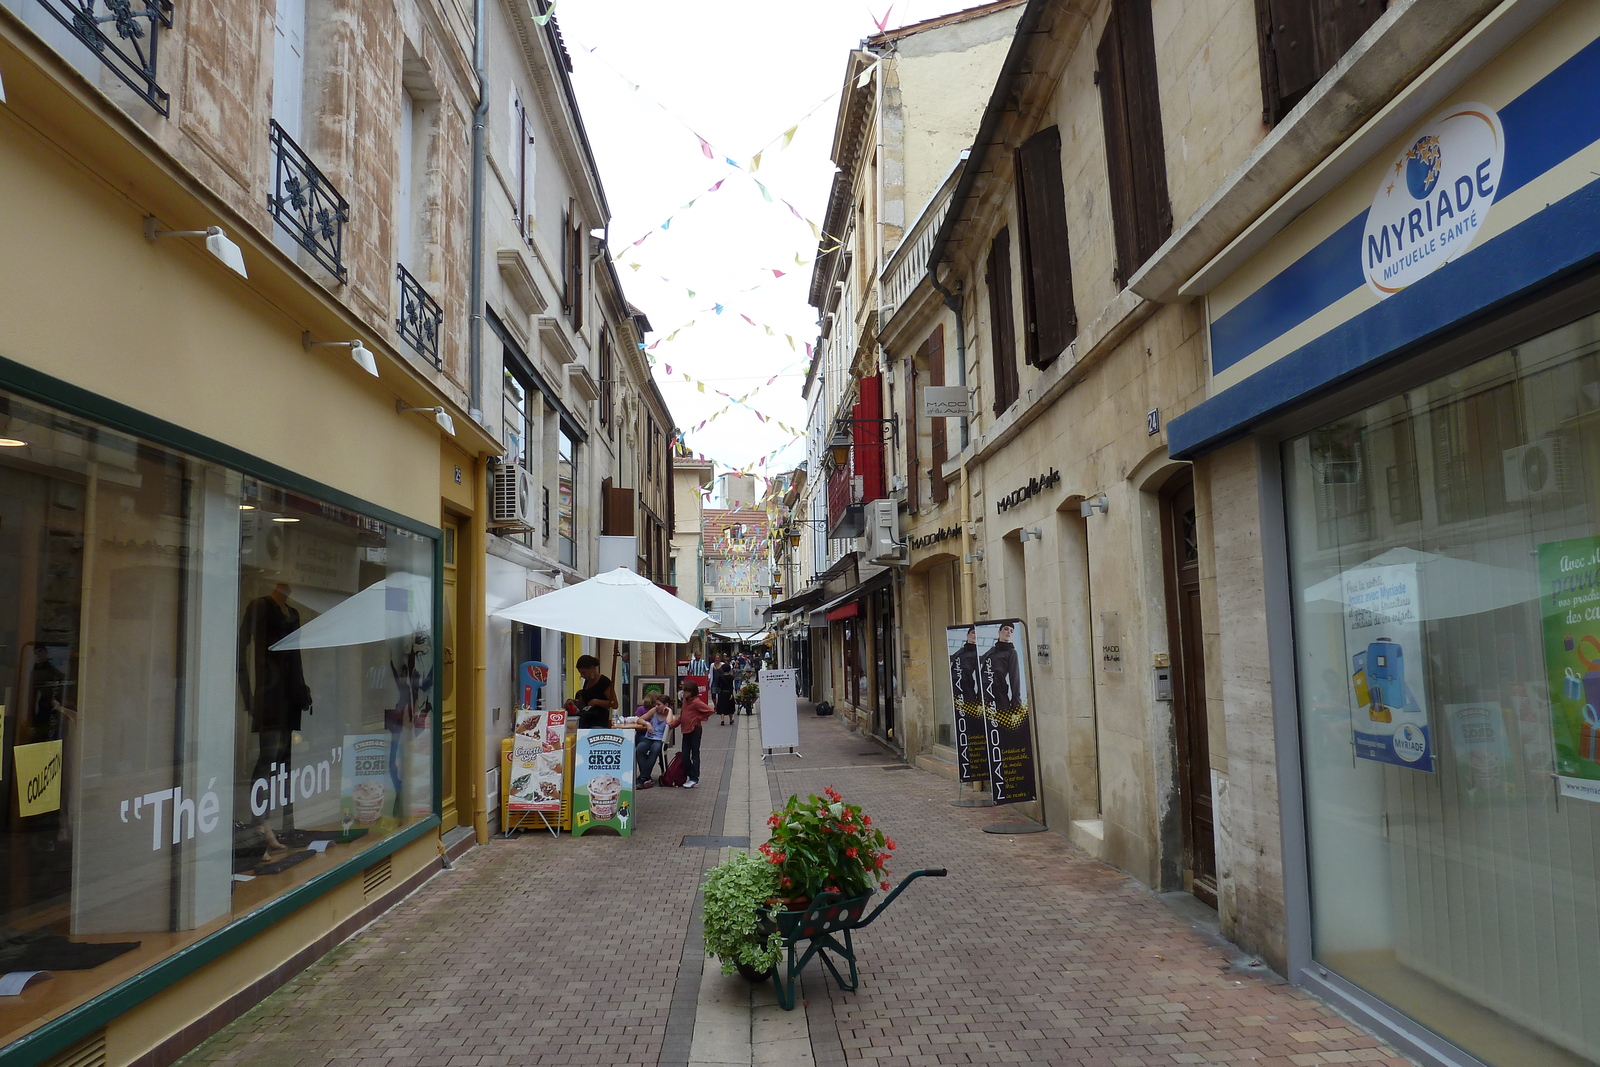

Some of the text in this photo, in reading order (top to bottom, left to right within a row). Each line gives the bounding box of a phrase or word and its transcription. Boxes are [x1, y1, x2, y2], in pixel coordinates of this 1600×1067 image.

[1368, 157, 1494, 269] MYRIADE
[1383, 209, 1478, 281] MUTUELLE SANTÉ
[1560, 556, 1585, 572] Avec
[1380, 582, 1407, 599] Myriade
[1566, 610, 1581, 624] des
[953, 657, 963, 692] Autres
[984, 658, 995, 698] Autres
[588, 755, 621, 764] GROS
[958, 718, 970, 778] MADO
[1394, 738, 1424, 752] MYRIADE
[27, 753, 61, 804] COLLECTION
[990, 729, 1005, 800] MADO
